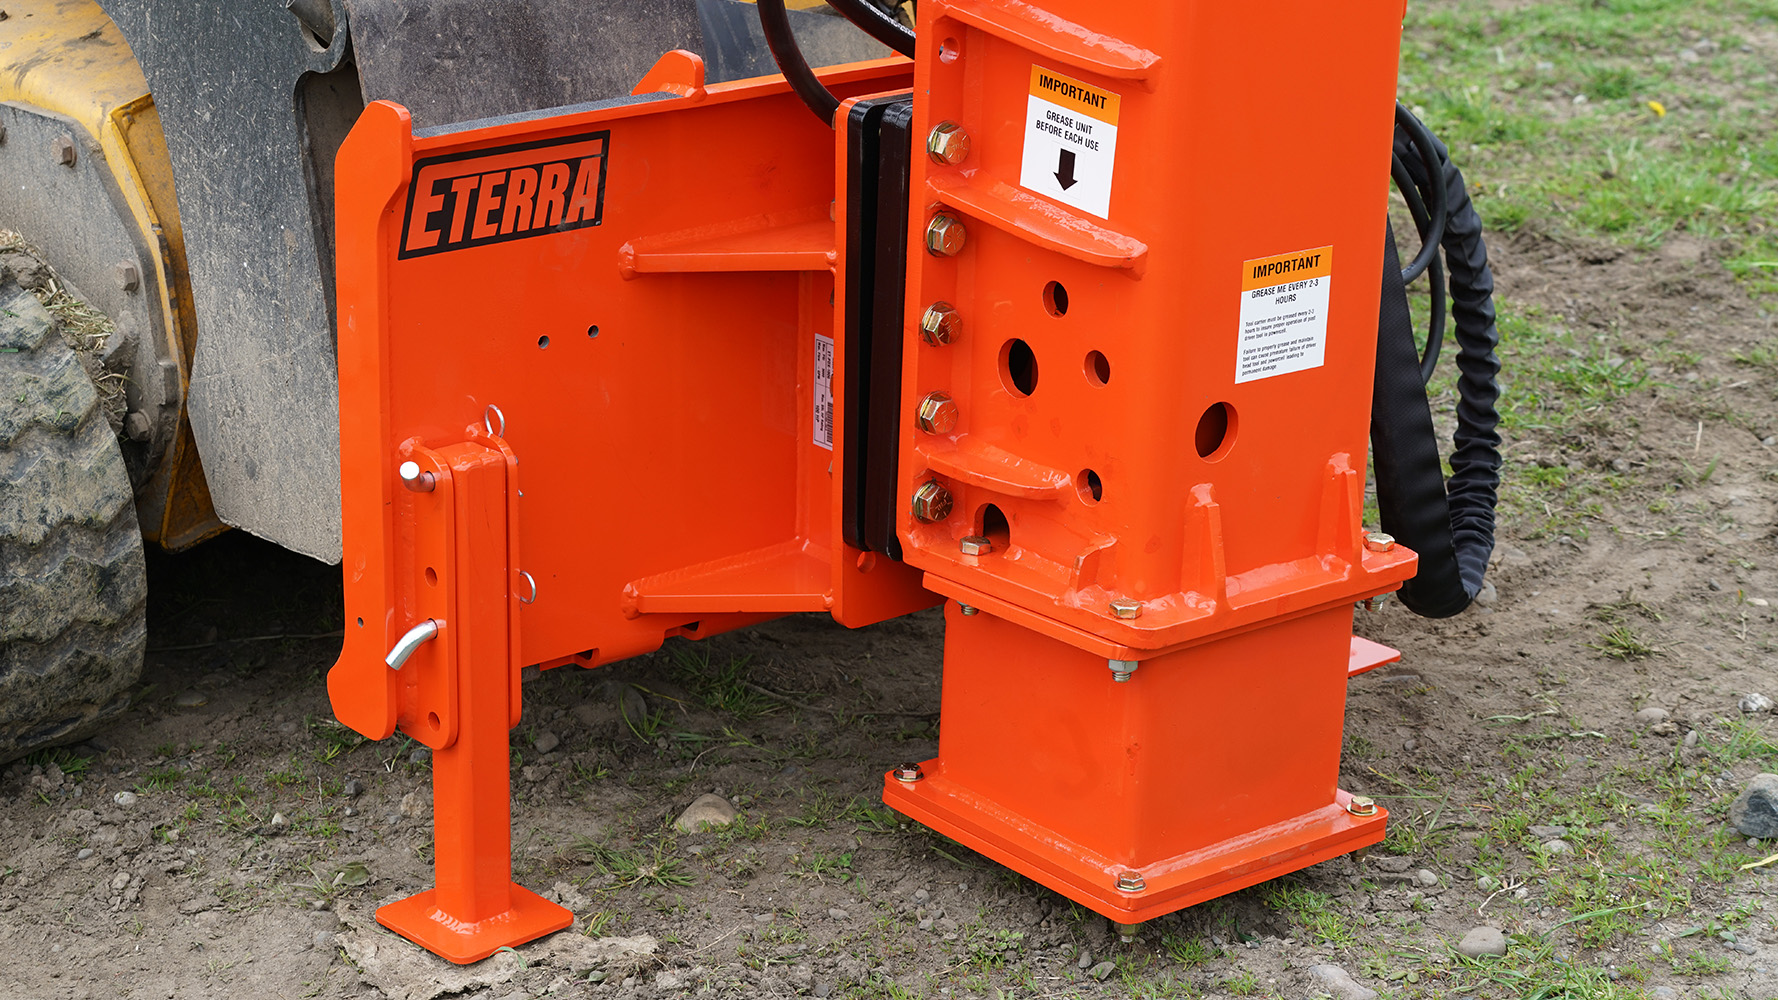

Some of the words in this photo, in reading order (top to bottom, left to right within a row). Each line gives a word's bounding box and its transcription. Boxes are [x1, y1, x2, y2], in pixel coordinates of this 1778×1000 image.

[1040, 74, 1107, 109] IMPORTANT
[1047, 110, 1073, 128] GREASE
[1076, 121, 1092, 135] UNIT
[1036, 120, 1062, 137] BEFORE
[1065, 130, 1083, 145] EACH
[1085, 138, 1099, 151] USE
[406, 139, 603, 251] ETERRA
[1253, 255, 1321, 279] IMPORTANT
[1252, 287, 1275, 298] GREASE
[1277, 285, 1286, 293] ME
[1288, 281, 1308, 291] EVERY
[1309, 279, 1319, 288] 2-3
[1275, 294, 1297, 304] HOURS
[1242, 368, 1261, 376] permanent
